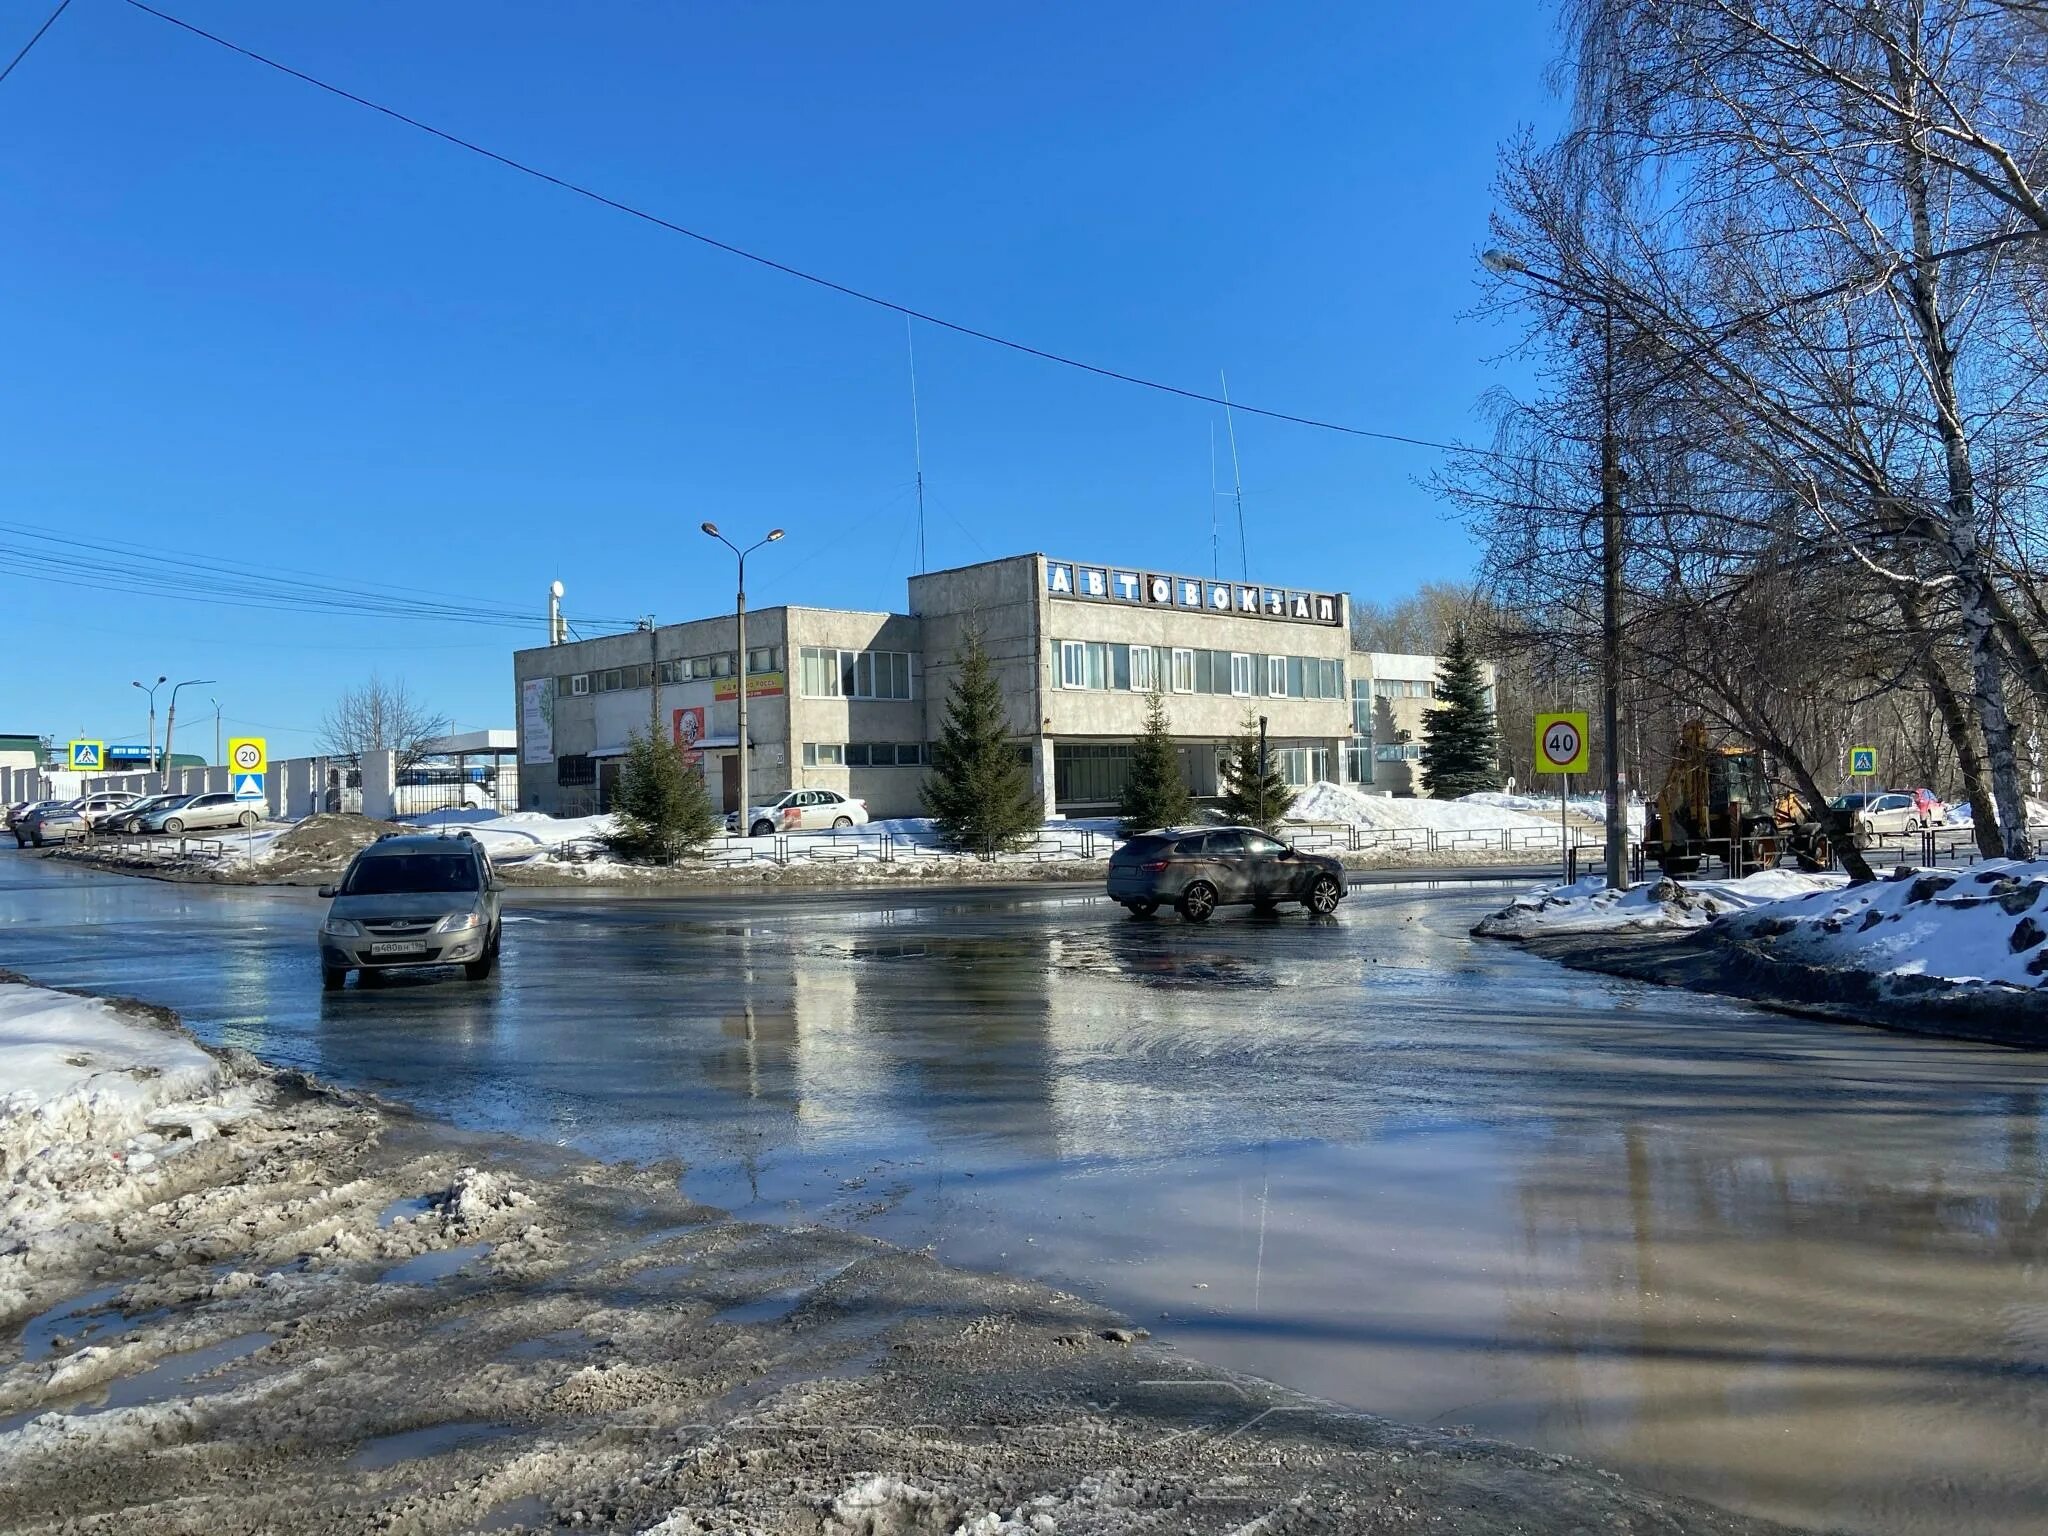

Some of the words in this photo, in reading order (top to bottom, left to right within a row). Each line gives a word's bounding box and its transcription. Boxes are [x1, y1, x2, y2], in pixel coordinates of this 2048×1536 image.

[1052, 567, 1334, 620] АВТОВОКЗАЛ
[1549, 734, 1574, 752] 40
[240, 751, 256, 762] 20
